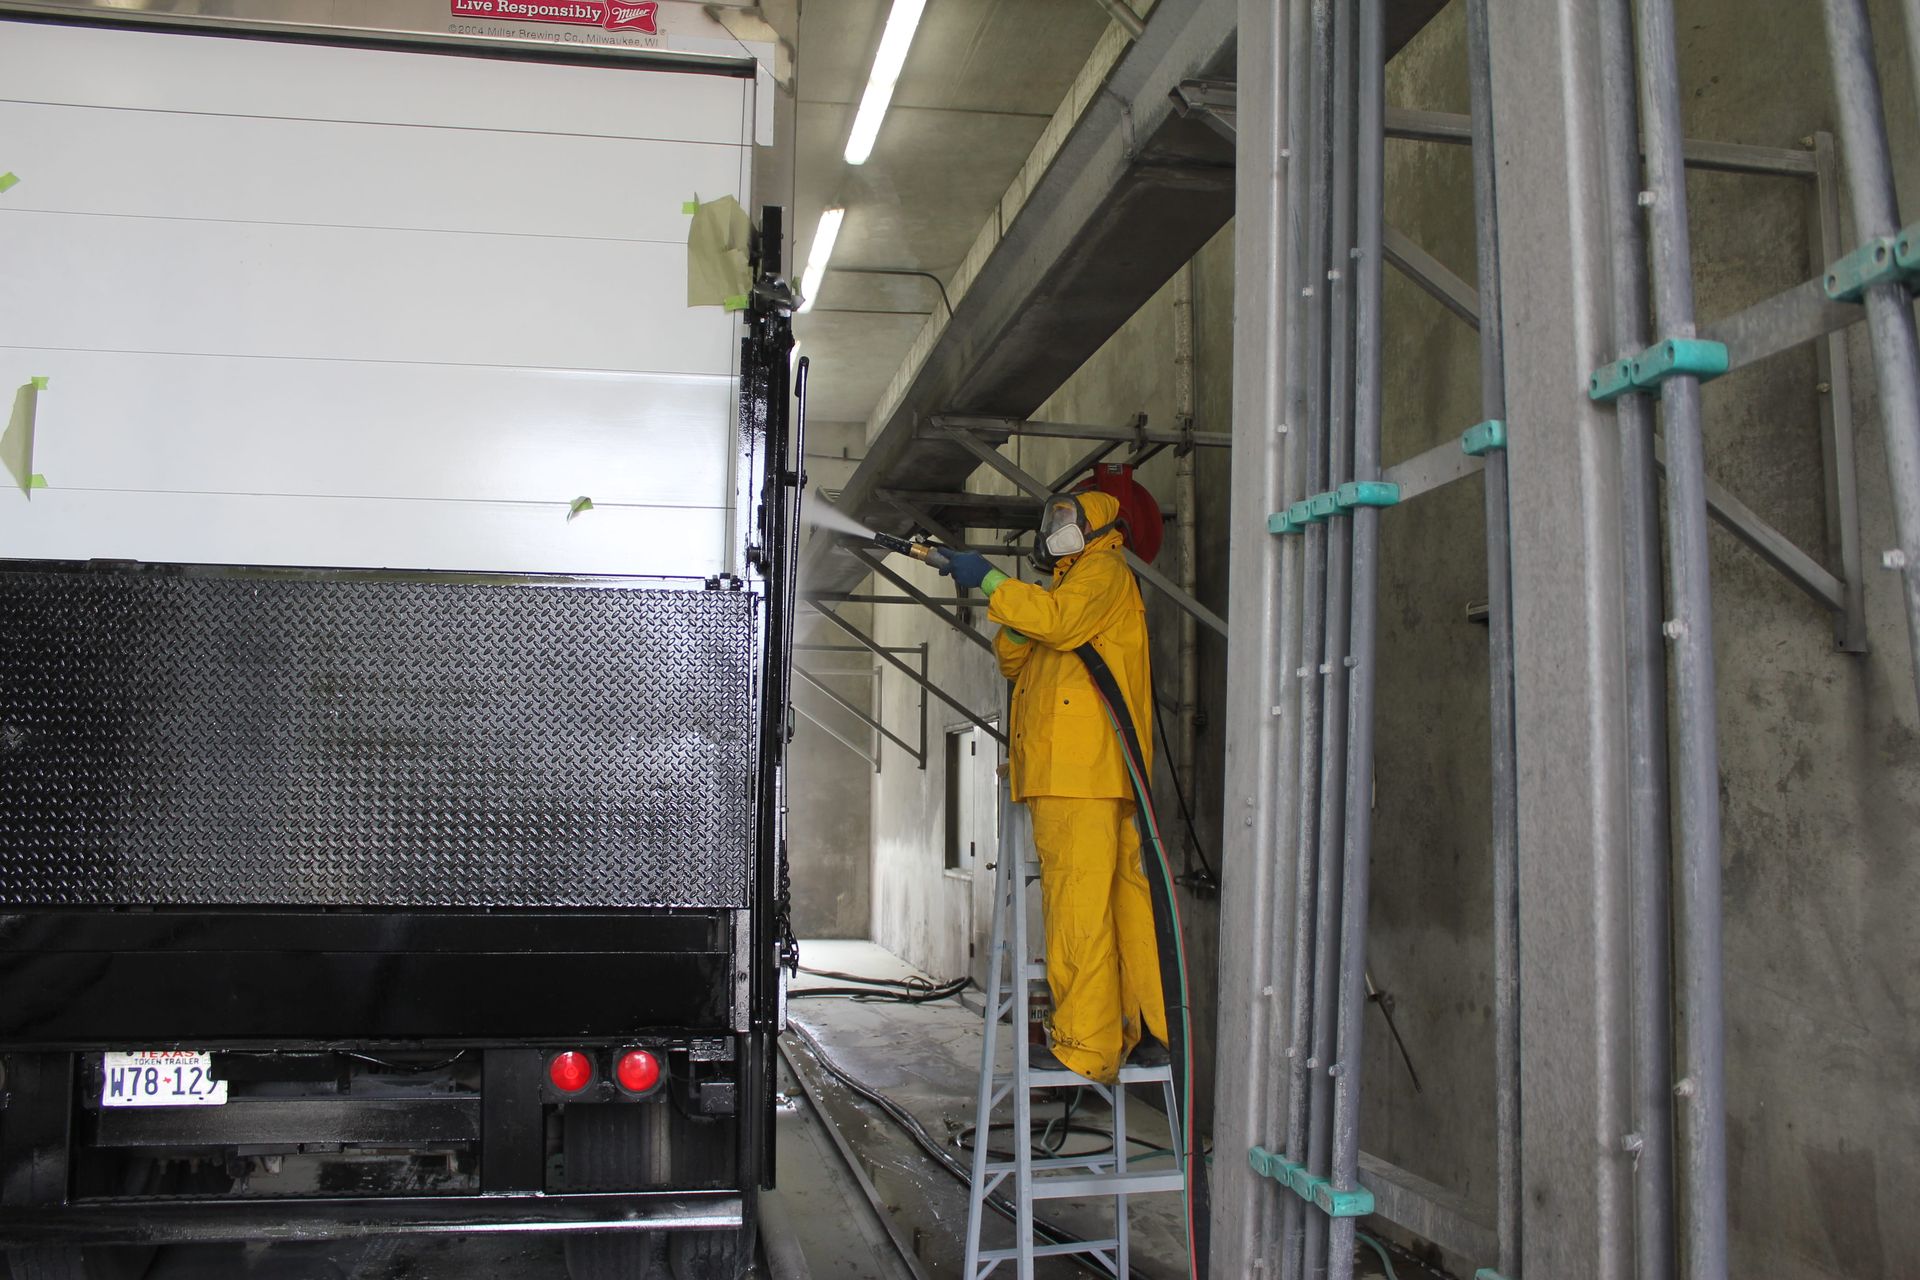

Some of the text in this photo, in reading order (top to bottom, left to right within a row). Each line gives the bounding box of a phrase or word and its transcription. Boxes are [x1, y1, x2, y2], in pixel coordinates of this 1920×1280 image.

[456, 0, 602, 22] Live Responsibly
[611, 7, 651, 24] Miller
[487, 27, 516, 38] Miller
[519, 29, 561, 42] Brewing
[586, 33, 643, 47] Milwaukee,
[644, 38, 659, 47] WI
[134, 1057, 200, 1066] TOKEN TRAILER
[110, 1067, 159, 1097] W78
